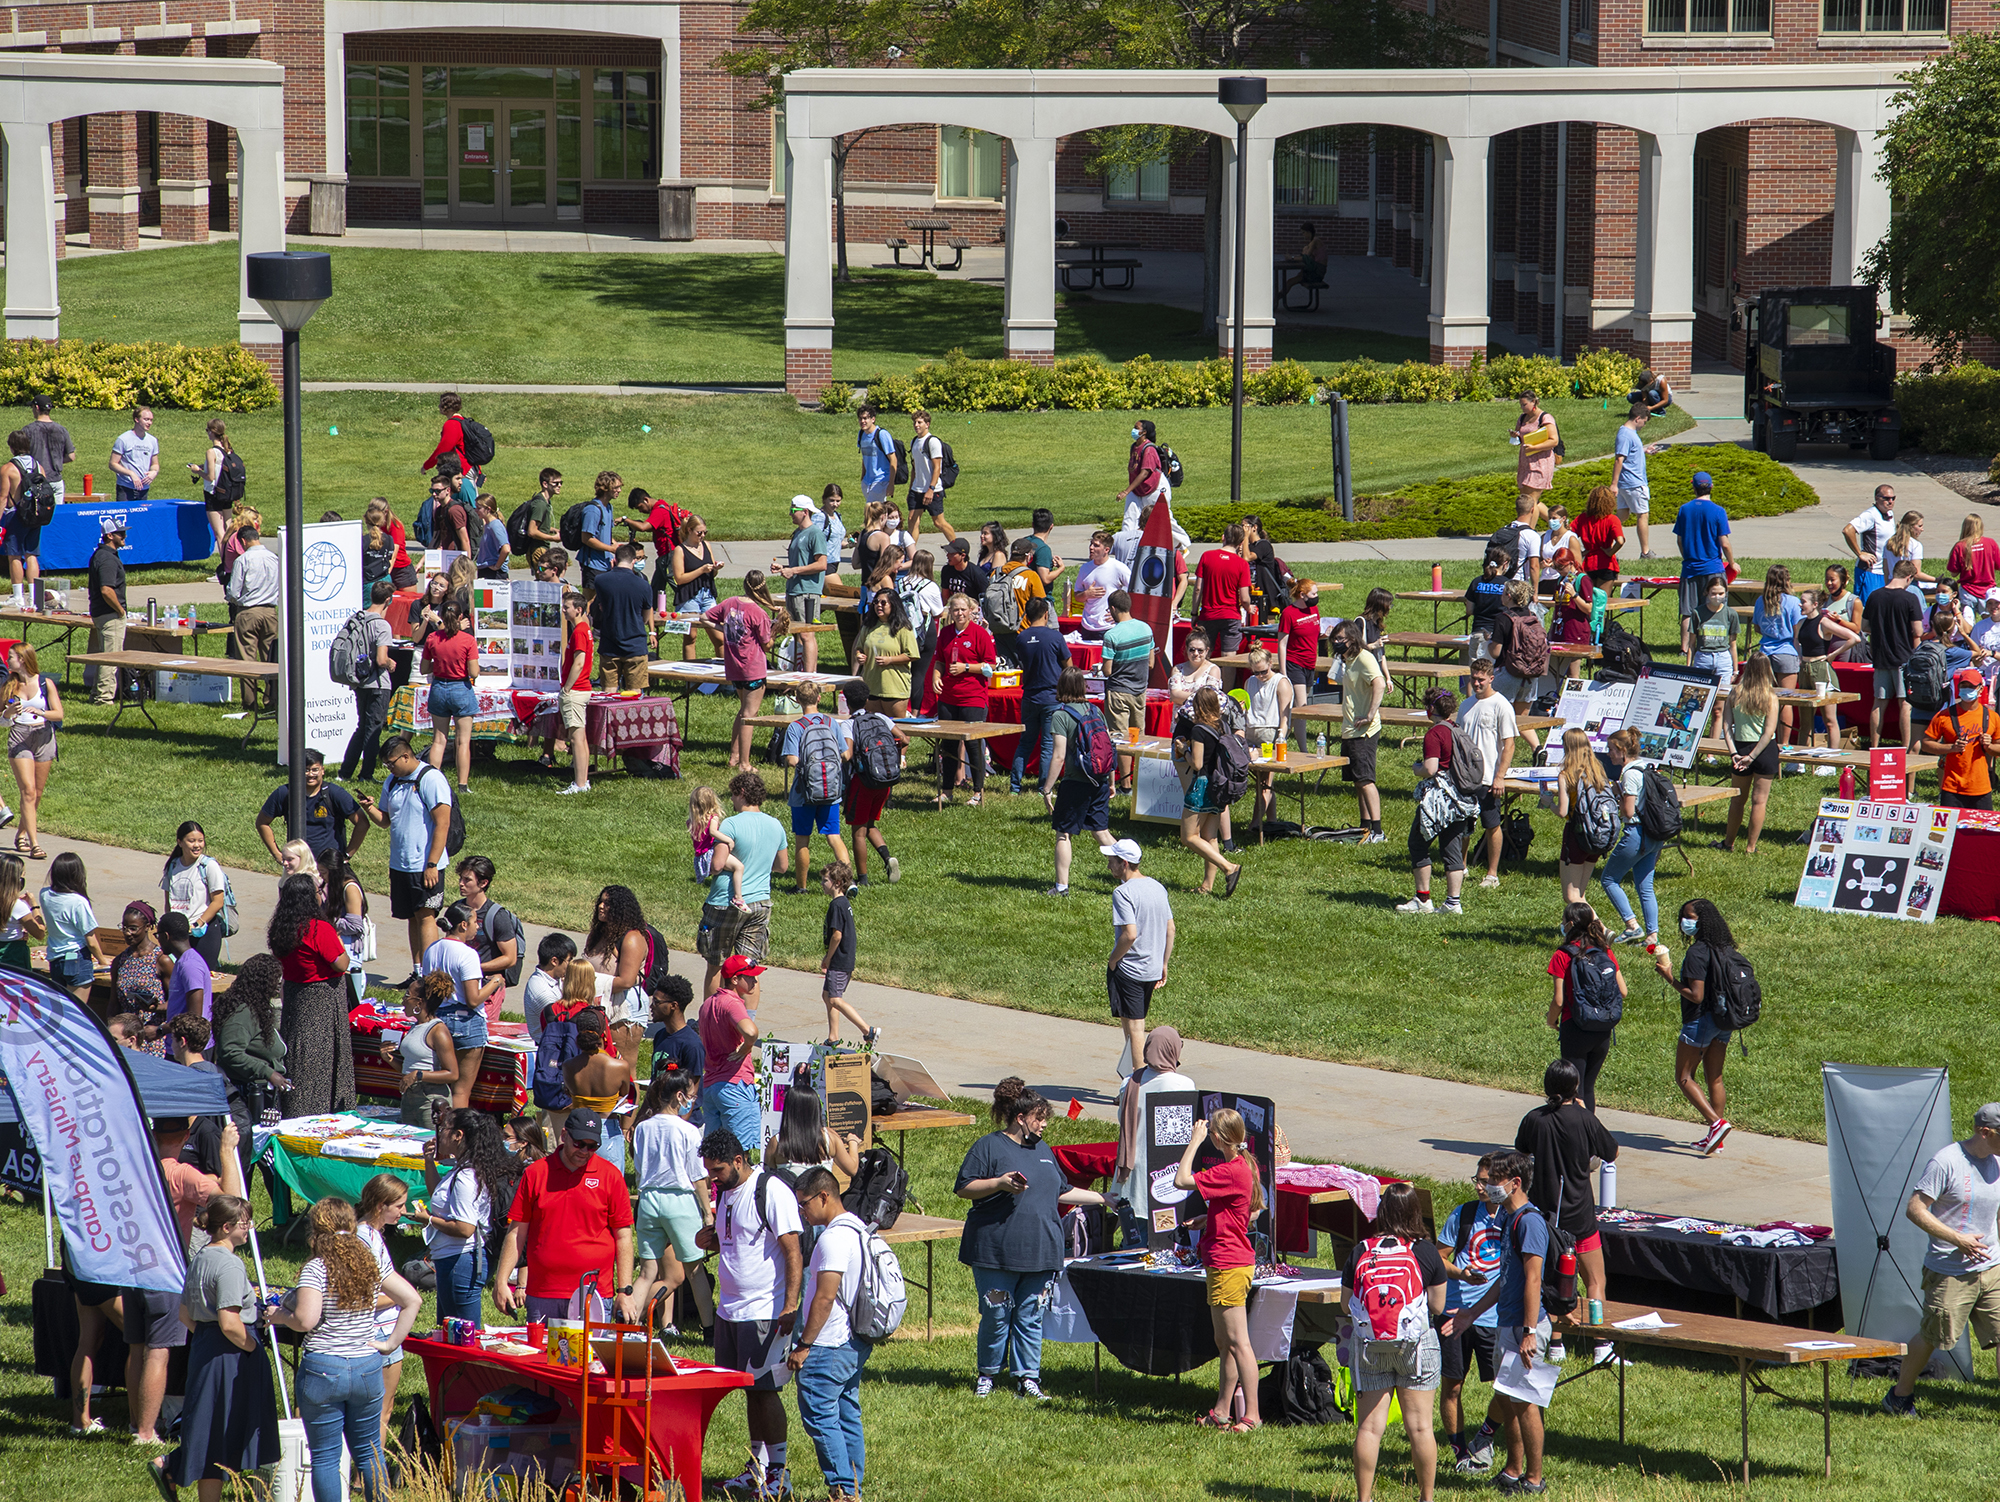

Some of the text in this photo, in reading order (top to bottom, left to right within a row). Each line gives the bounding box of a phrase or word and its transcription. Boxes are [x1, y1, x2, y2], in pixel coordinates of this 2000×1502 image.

[1477, 582, 1505, 592] amsa
[311, 623, 344, 635] WITHO
[345, 694, 354, 704] of
[308, 711, 346, 724] Nebraska
[311, 728, 343, 740] Chapter
[1884, 754, 1893, 762] N
[1832, 804, 1849, 814] BISA
[1934, 812, 1949, 827] N
[1152, 1164, 1179, 1179] Traditi
